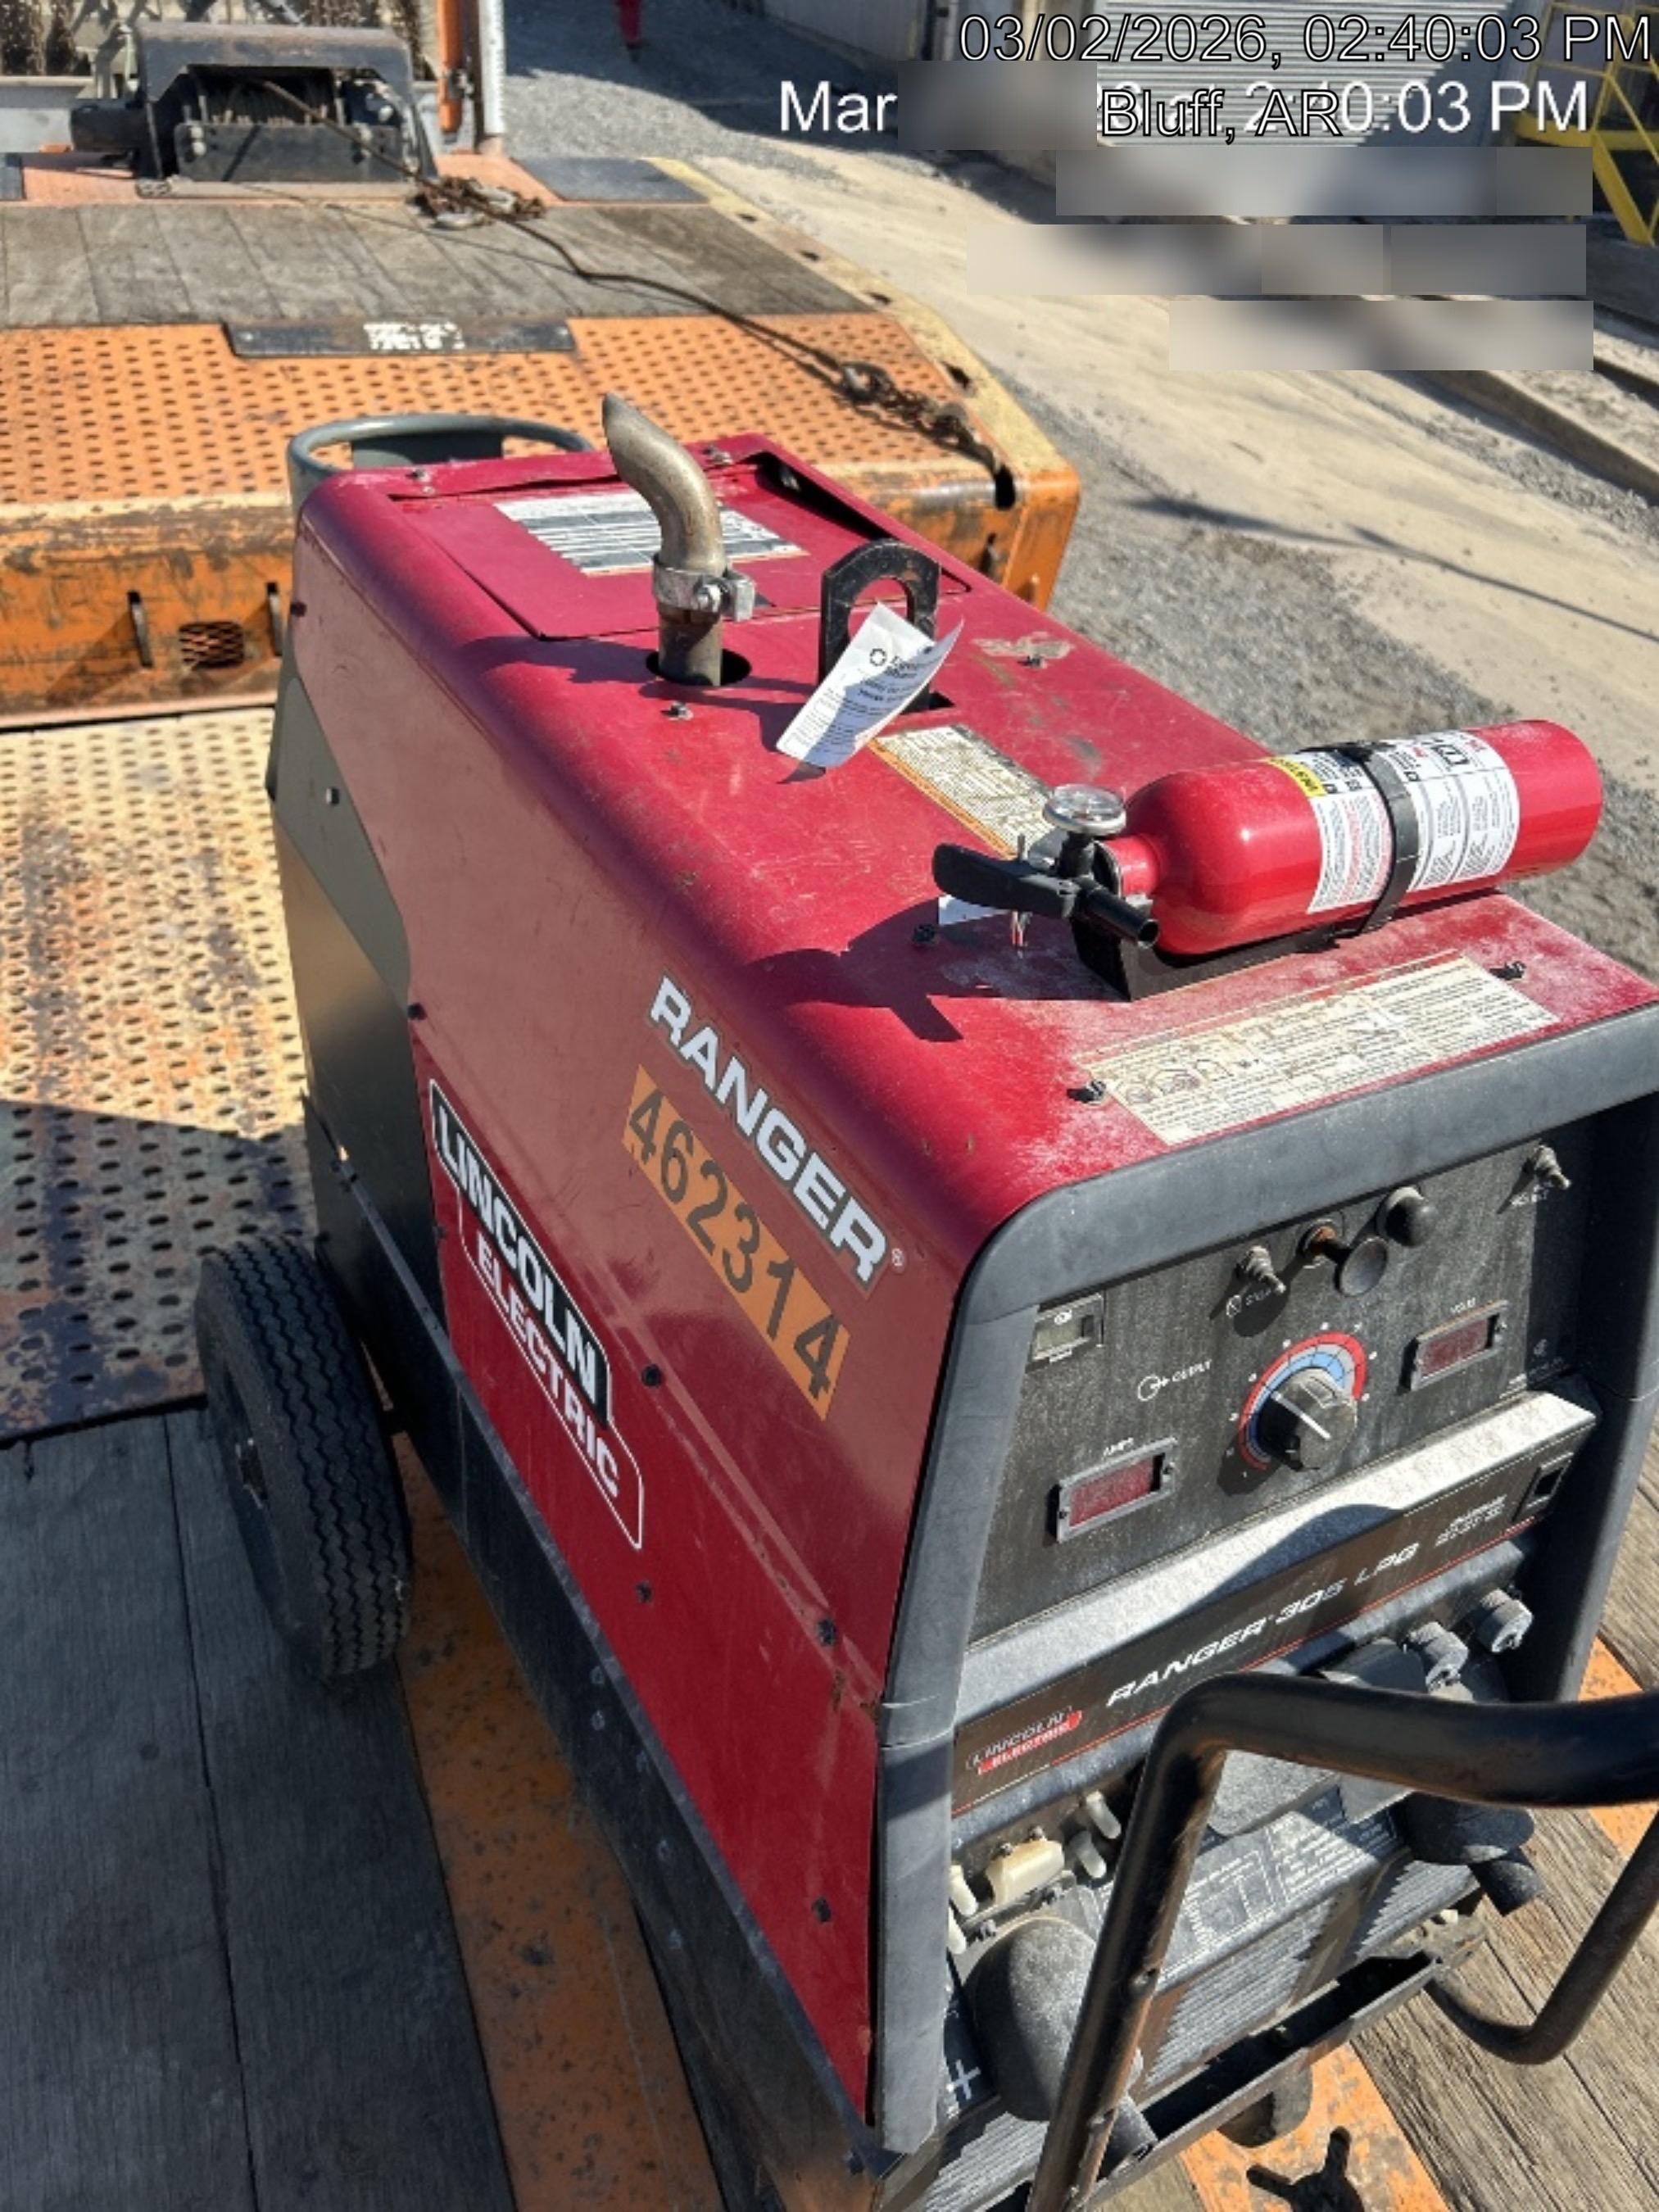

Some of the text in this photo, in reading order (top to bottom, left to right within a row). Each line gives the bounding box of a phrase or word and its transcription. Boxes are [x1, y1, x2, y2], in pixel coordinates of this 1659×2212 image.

[438, 1104, 598, 1405] LINCOLN
[475, 1231, 620, 1499] ELECTRIC
[628, 1090, 842, 1400] 462314
